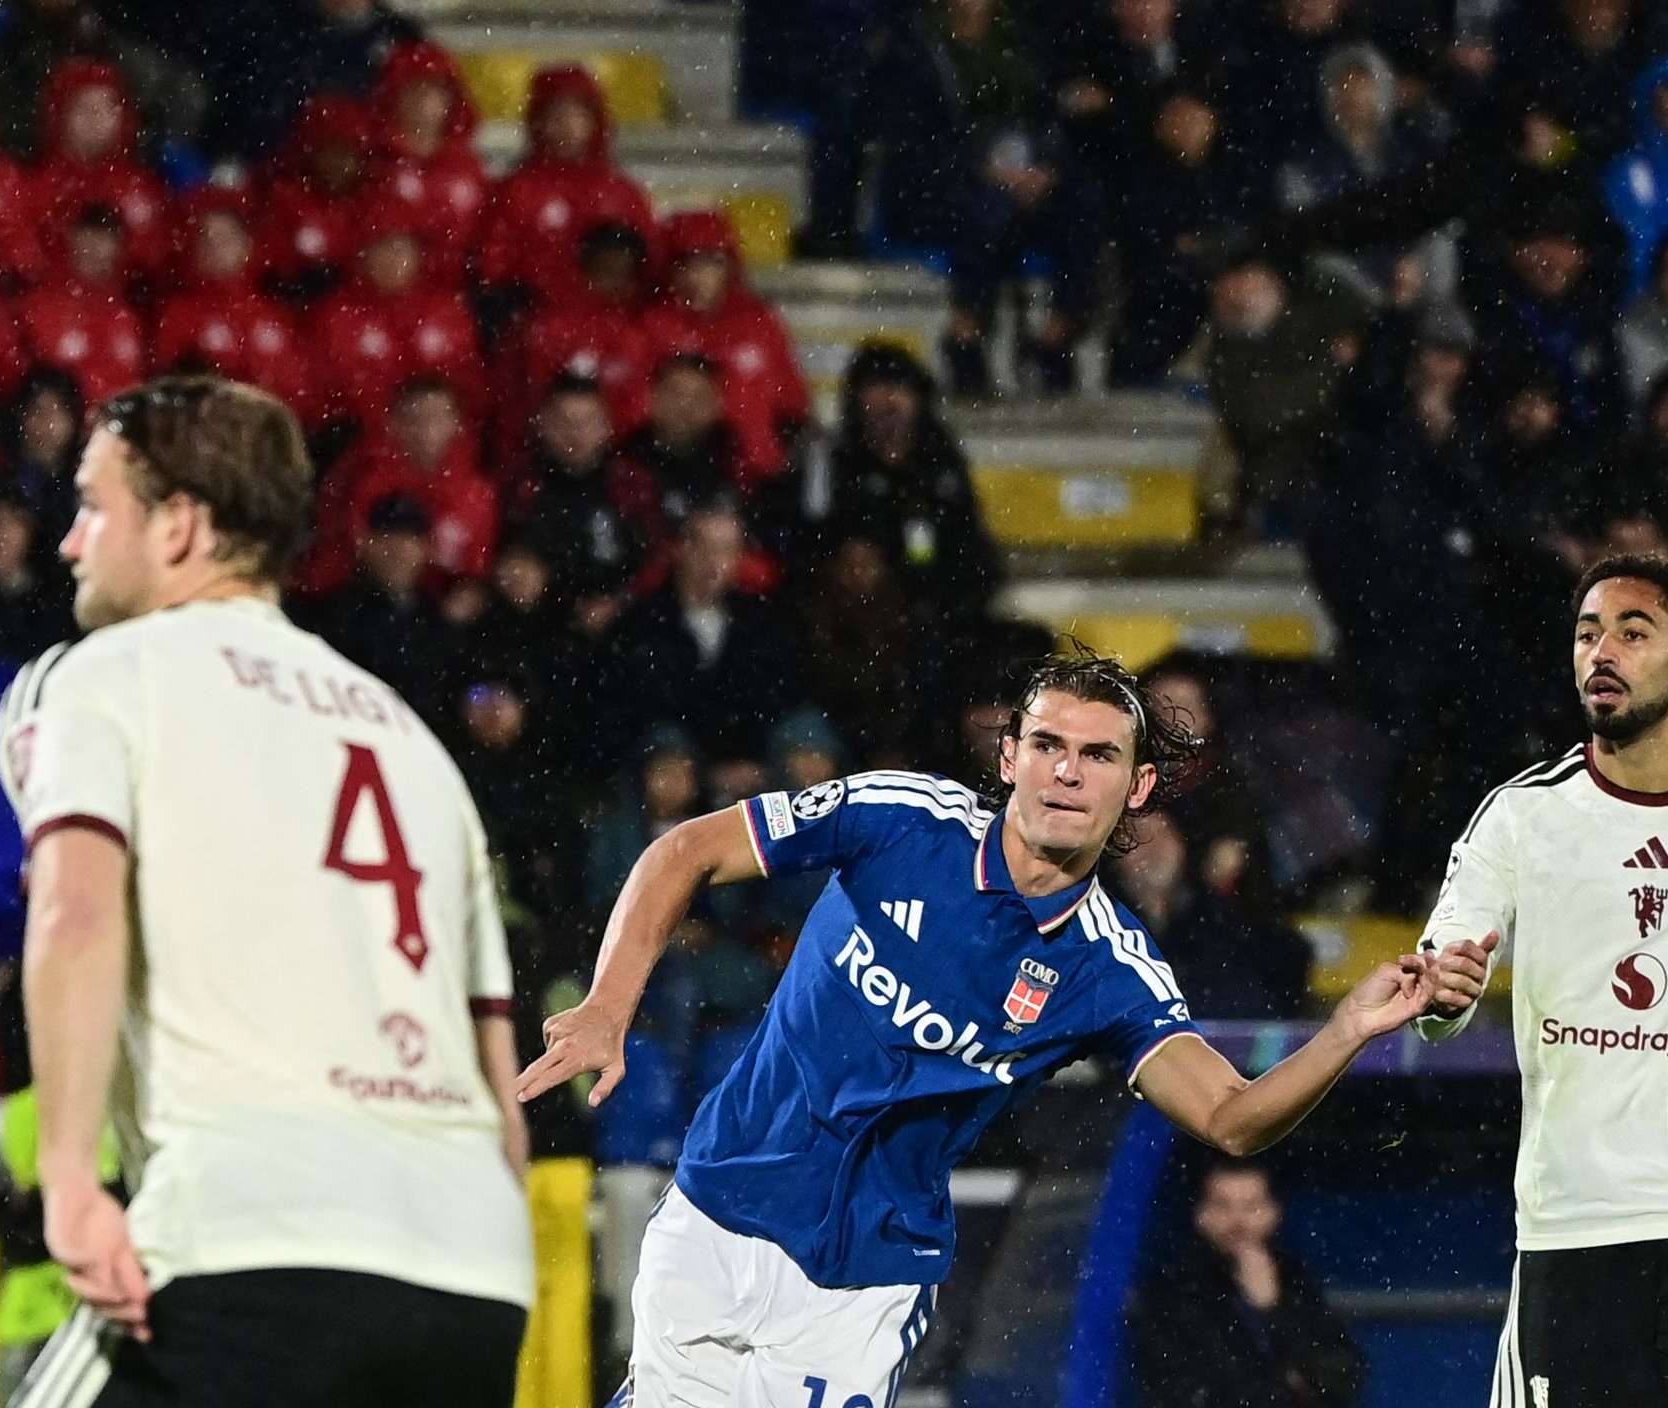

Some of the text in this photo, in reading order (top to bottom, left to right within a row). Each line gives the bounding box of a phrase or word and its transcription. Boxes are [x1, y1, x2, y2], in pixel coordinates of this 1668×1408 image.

[325, 739, 429, 972] 4
[834, 923, 1028, 1085] Revolut
[1020, 957, 1060, 985] COMO
